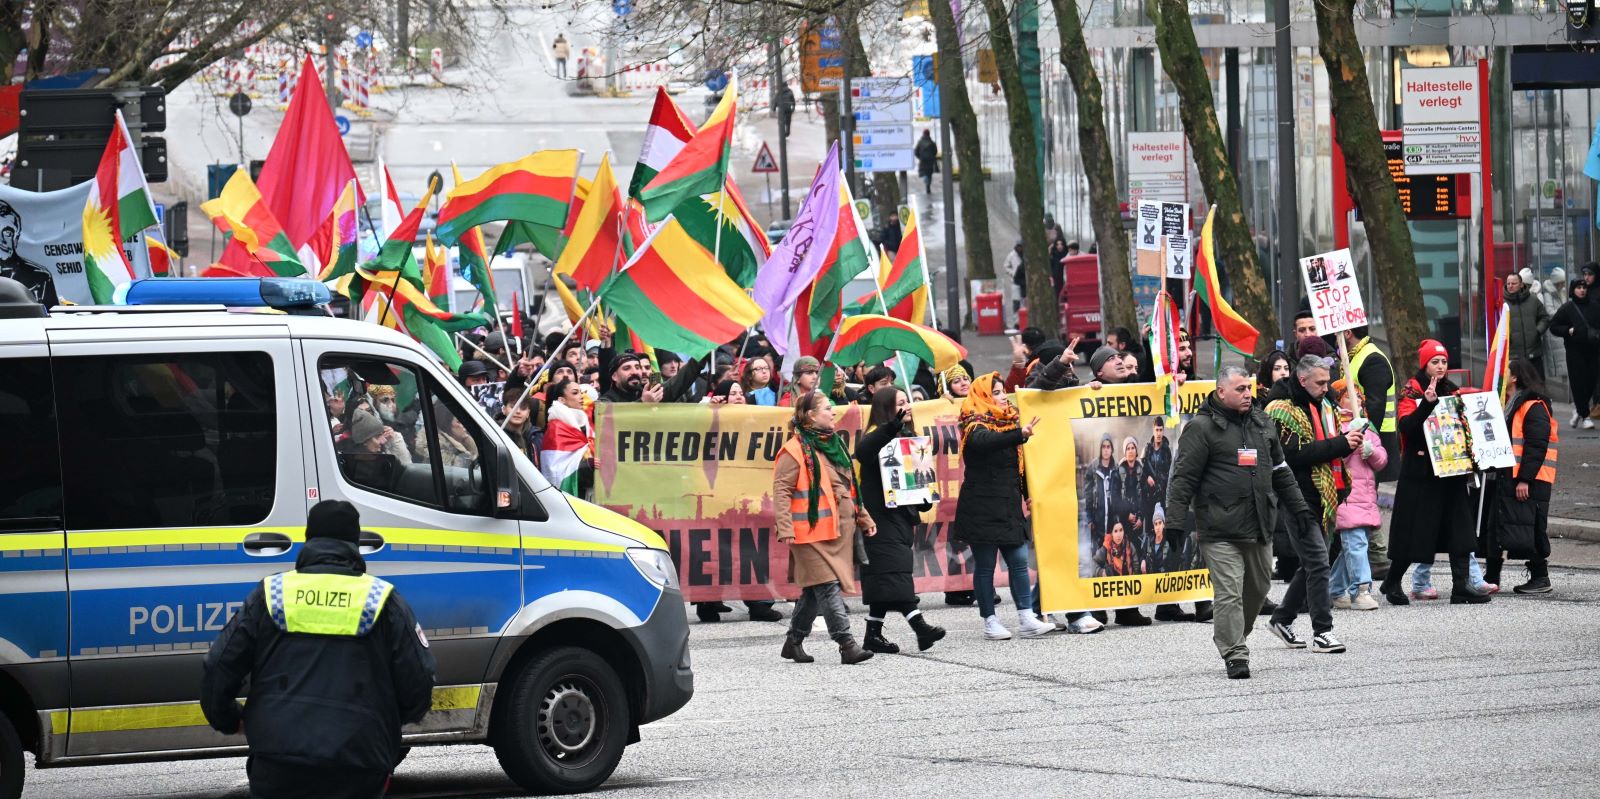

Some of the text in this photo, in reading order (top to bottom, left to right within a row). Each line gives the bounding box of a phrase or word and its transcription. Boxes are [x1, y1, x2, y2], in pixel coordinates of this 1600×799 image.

[1407, 80, 1473, 92] Haltestelle
[1419, 95, 1463, 108] verlegt
[1132, 143, 1181, 151] Haltestelle
[1141, 153, 1173, 163] verlegt
[44, 242, 83, 257] CENGAW
[1315, 286, 1350, 309] STOP
[1080, 395, 1152, 418] DEFEND
[618, 431, 739, 462] FRIEDEN
[746, 426, 792, 461] FÜ
[1093, 580, 1142, 598] DEFEND
[296, 589, 351, 608] POLIZEI
[130, 601, 244, 635] POLIZE
